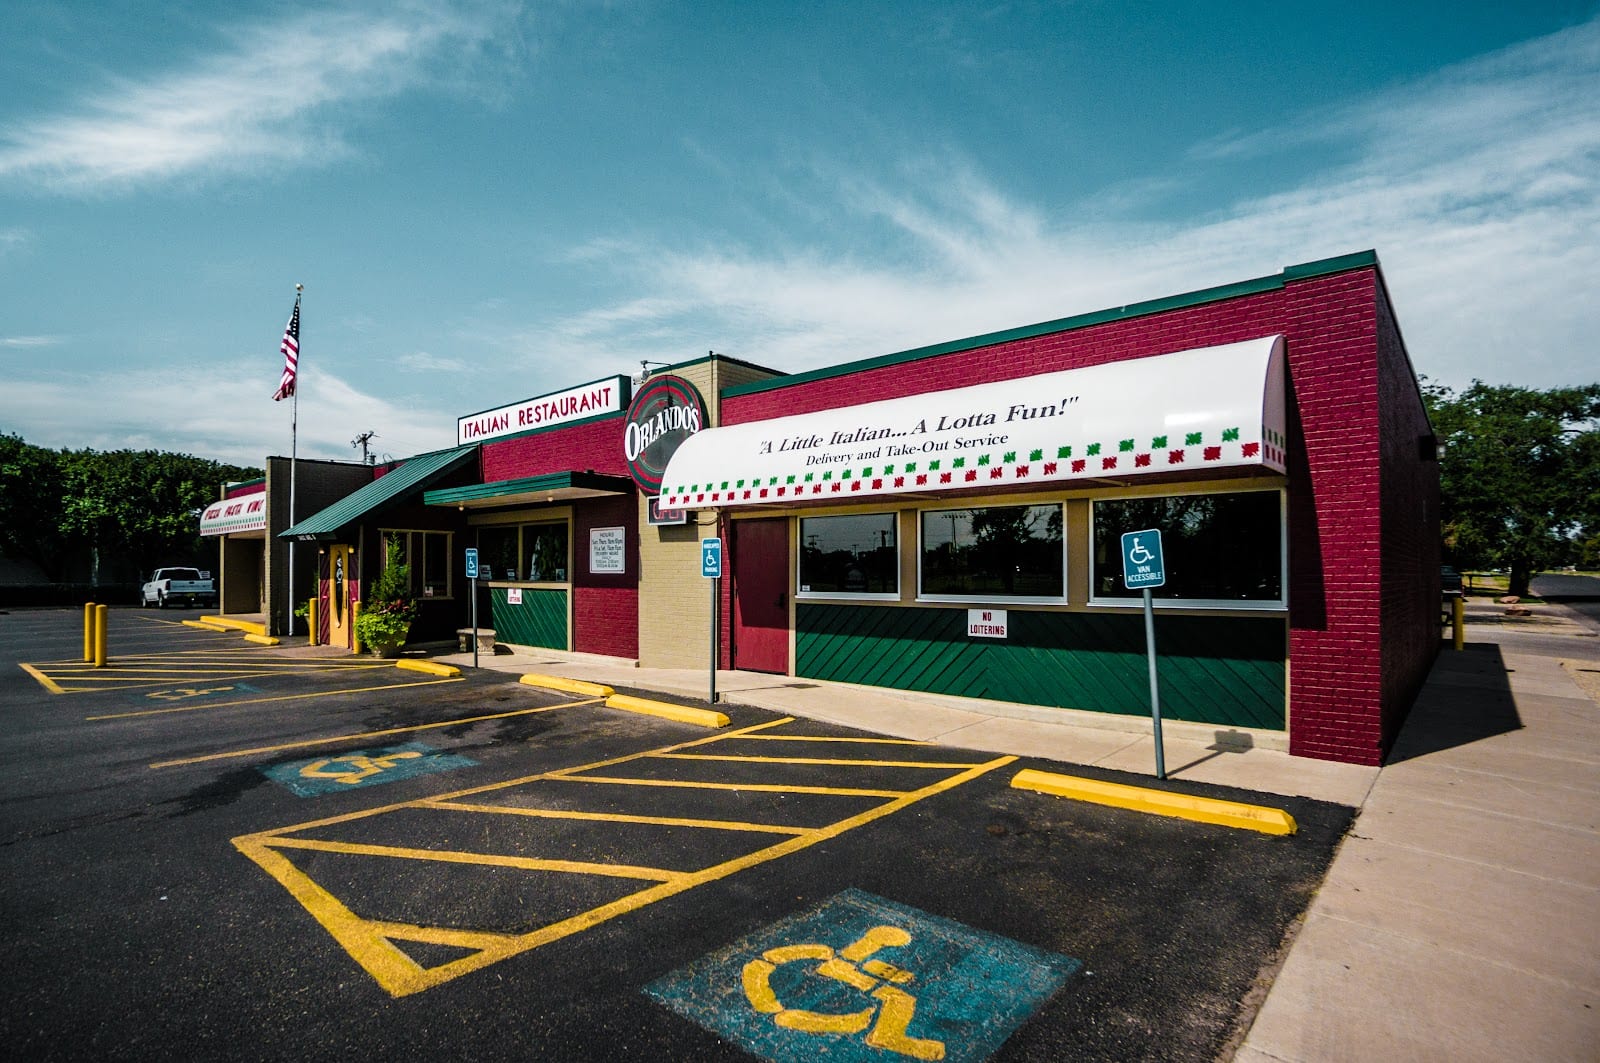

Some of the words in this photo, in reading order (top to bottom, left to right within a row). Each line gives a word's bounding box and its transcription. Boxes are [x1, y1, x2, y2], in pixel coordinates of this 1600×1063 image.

[464, 413, 509, 439] ITALIAN
[518, 387, 611, 426] RESTAURANT
[778, 434, 824, 453] Little
[911, 418, 928, 435] A
[935, 411, 997, 433] Lotta
[1003, 396, 1080, 423] Fun!"
[624, 402, 700, 461] ORLANDO'S
[805, 452, 854, 467] Delivery
[856, 447, 881, 461] and
[885, 440, 949, 458] Take-Out
[952, 432, 1009, 450] Service
[1128, 571, 1162, 582] ACCESSIBLE
[1137, 565, 1151, 573] VAN
[982, 611, 992, 621] NO
[970, 624, 1005, 635] LOITERING
